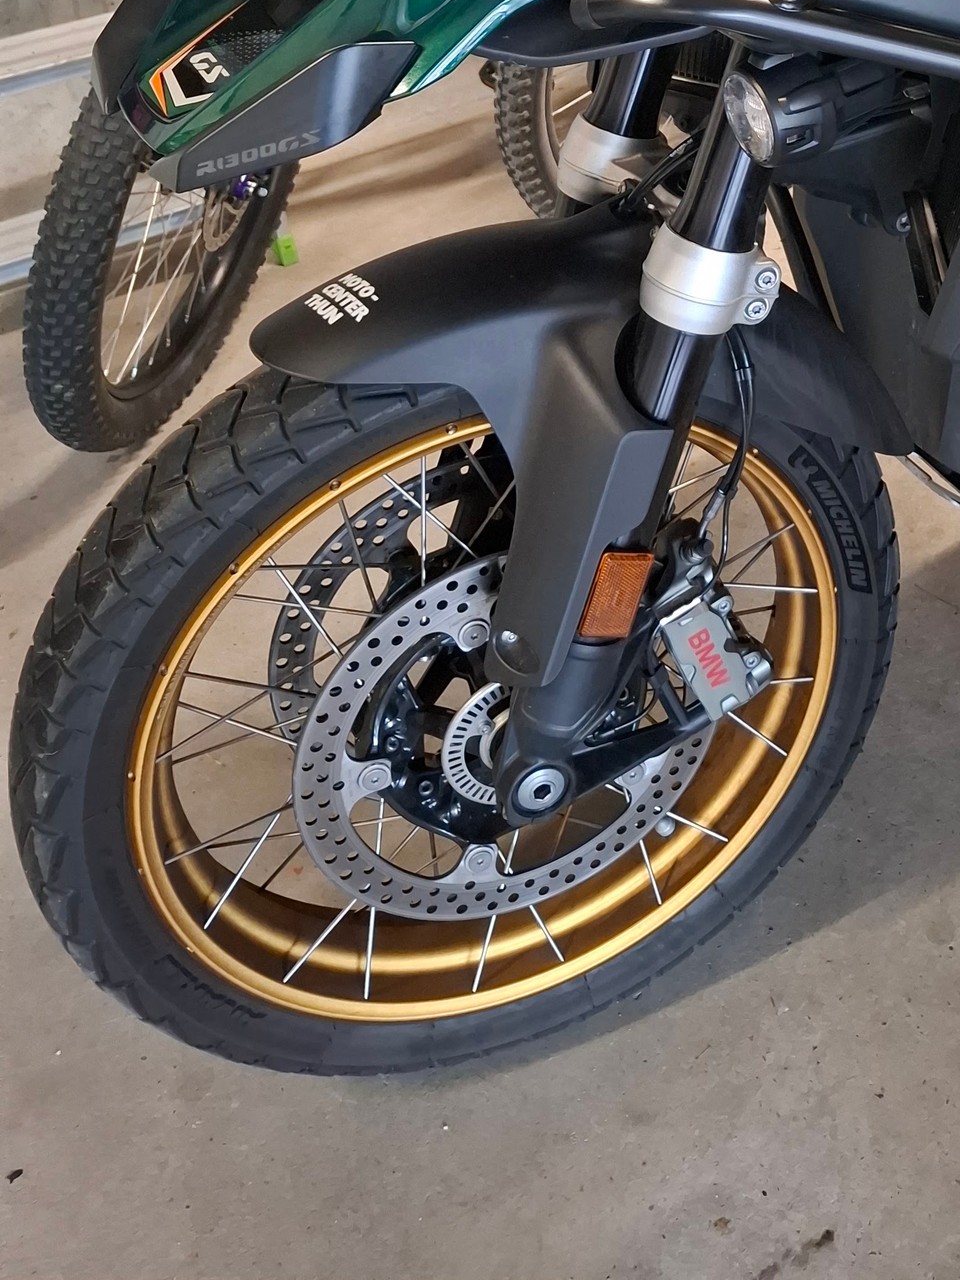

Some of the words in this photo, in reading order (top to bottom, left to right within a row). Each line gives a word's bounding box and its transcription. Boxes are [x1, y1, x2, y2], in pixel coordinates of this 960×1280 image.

[189, 52, 230, 84] GS
[304, 293, 344, 325] THUN
[322, 283, 370, 323] CENTER
[811, 479, 868, 588] MICHELIN
[687, 627, 731, 688] BMW
